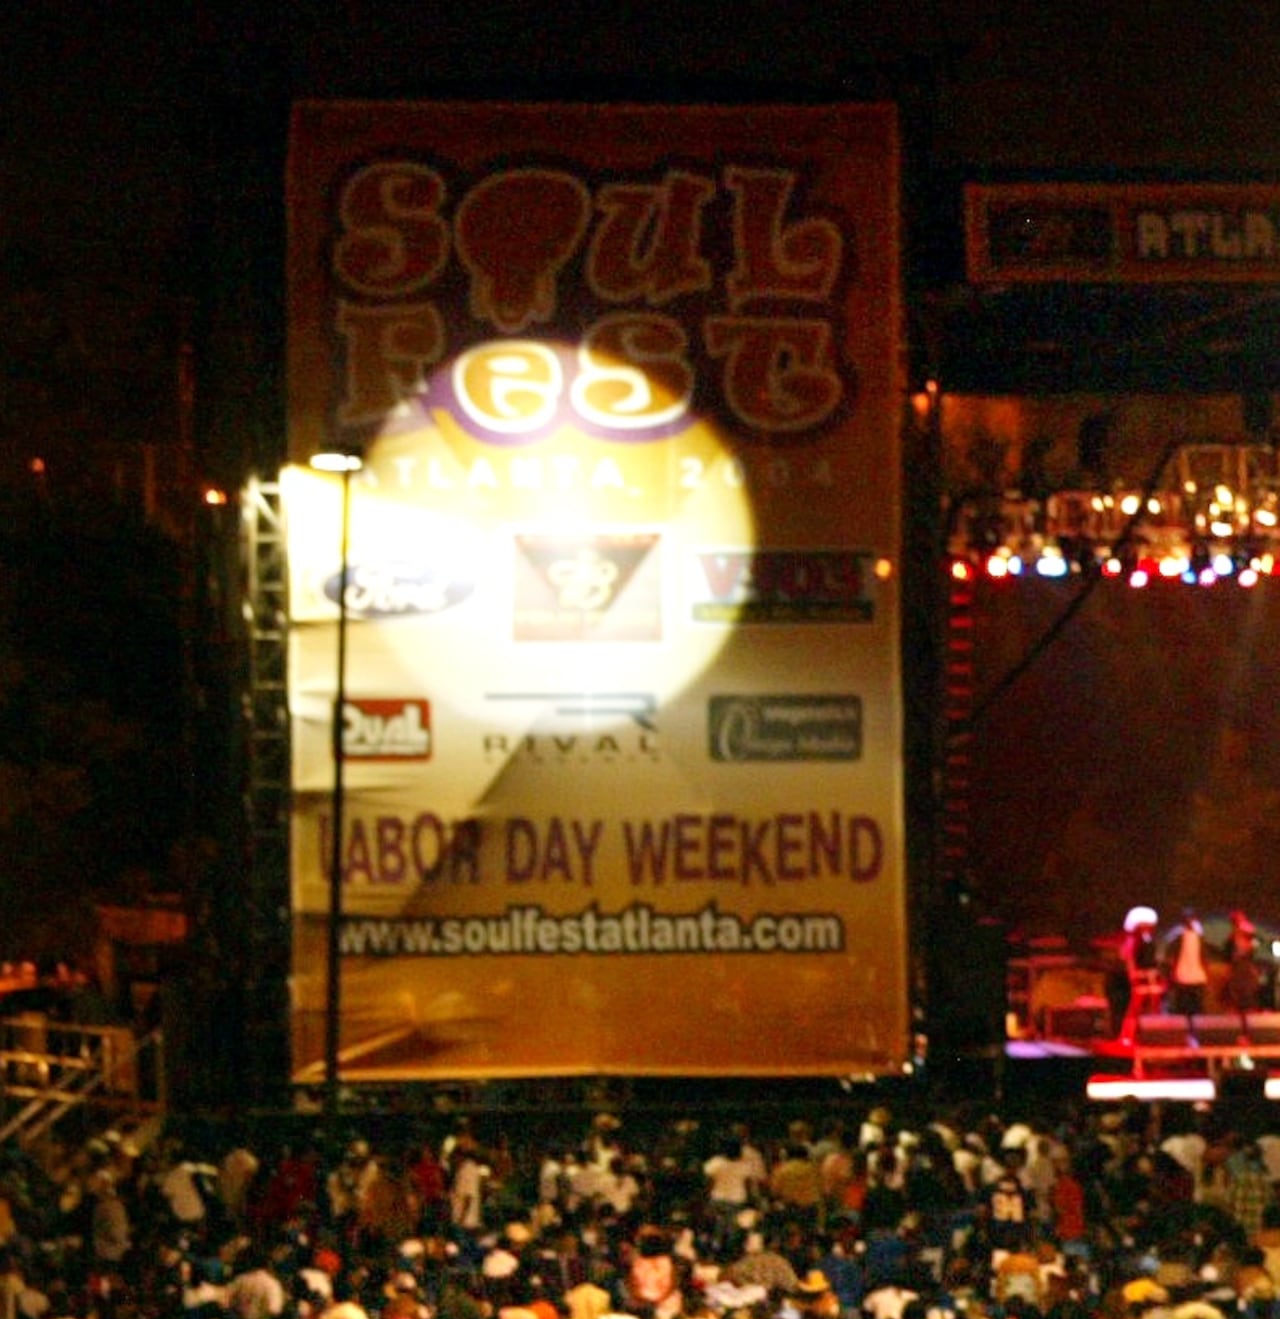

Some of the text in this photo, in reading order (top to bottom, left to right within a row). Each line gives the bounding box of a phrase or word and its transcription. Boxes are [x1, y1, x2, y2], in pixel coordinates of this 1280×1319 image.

[483, 734, 659, 754] RIVAL
[317, 811, 884, 887] LABOR DAY WEEKEND
[340, 906, 842, 953] www.soulfestatlanta.com
